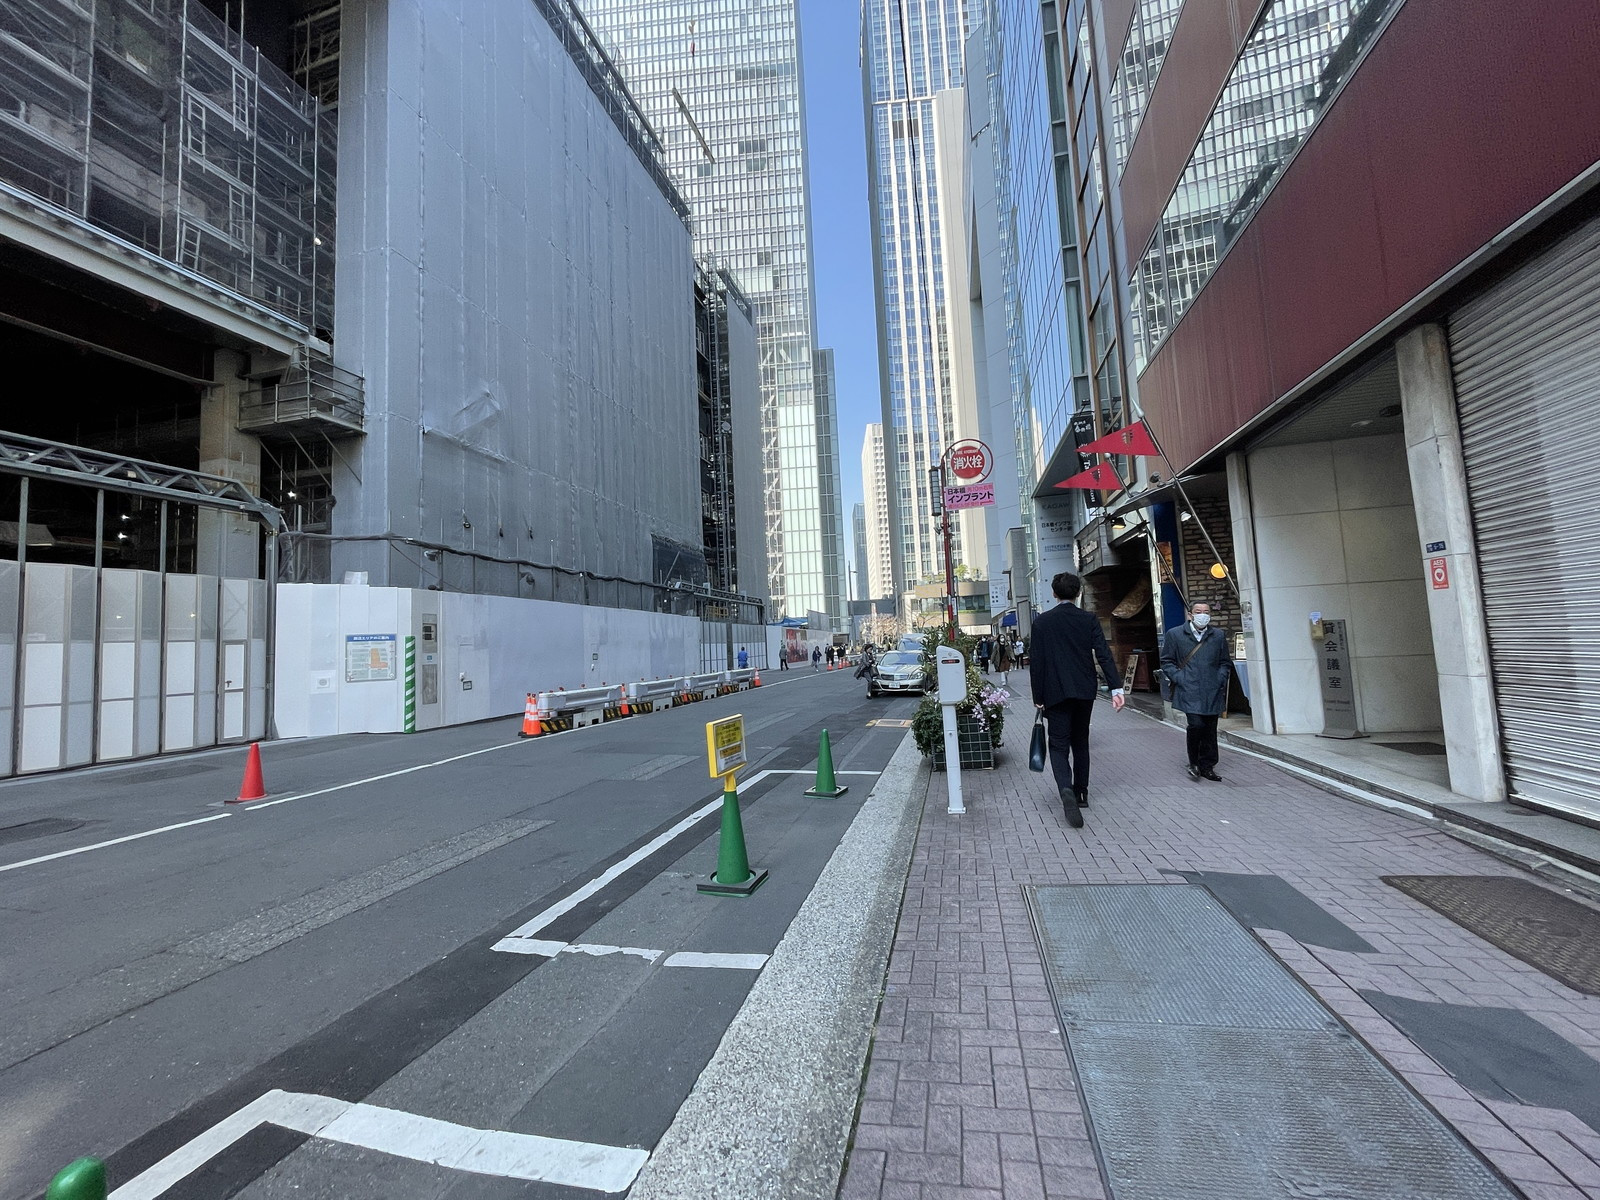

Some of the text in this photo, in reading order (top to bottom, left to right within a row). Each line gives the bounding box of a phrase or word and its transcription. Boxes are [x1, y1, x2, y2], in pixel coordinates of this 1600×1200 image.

[953, 454, 983, 470] 消火栓
[948, 491, 994, 503] インプラント
[1323, 622, 1342, 689] 貸会議室
